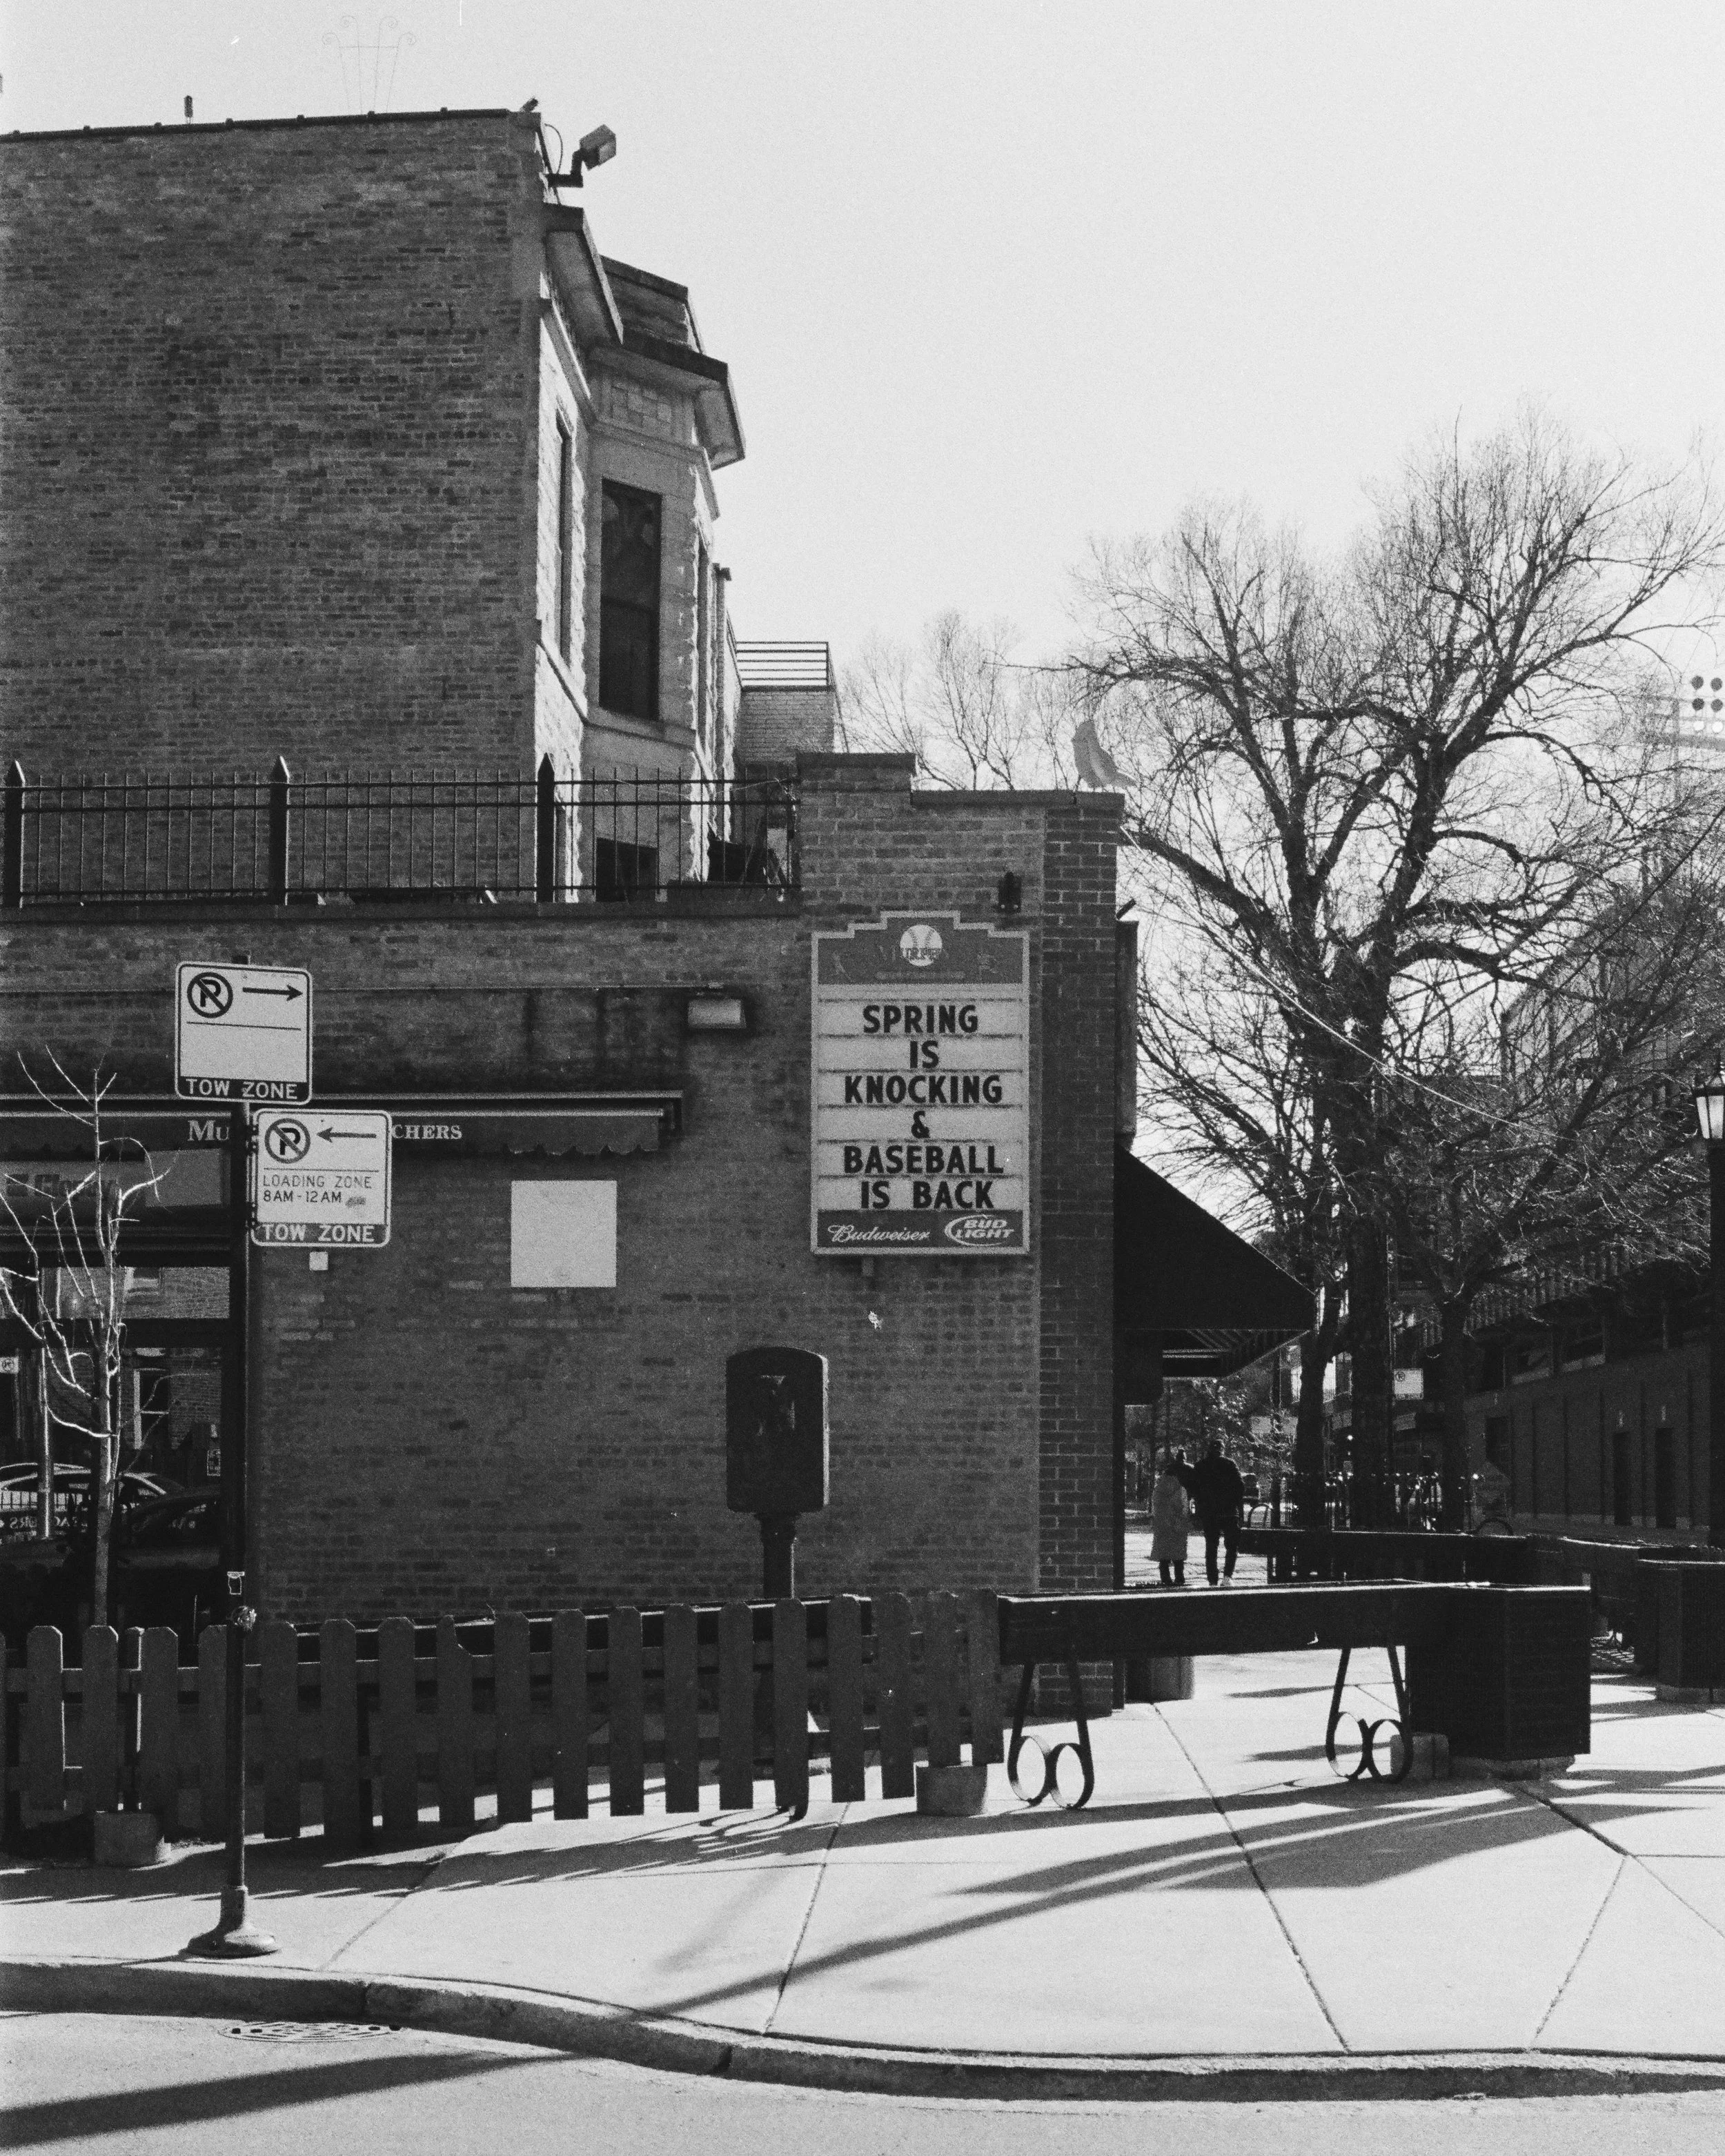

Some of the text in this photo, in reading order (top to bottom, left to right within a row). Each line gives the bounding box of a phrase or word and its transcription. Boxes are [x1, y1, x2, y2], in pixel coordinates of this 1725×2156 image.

[862, 1005, 978, 1034] SPRING
[909, 1040, 940, 1069] IS
[186, 1078, 297, 1100] TOW ZONE
[844, 1075, 1003, 1104] KNOCKING
[911, 1110, 931, 1138] &
[843, 1145, 1004, 1174] BASEBALL
[263, 1174, 372, 1189] LOADING ZONE
[860, 1180, 994, 1209] IS BACK
[262, 1224, 375, 1242] TOW ZONE
[827, 1225, 931, 1243] Budweiser
[955, 1229, 1014, 1238] LIGHT
[963, 1219, 1007, 1229] BUD
